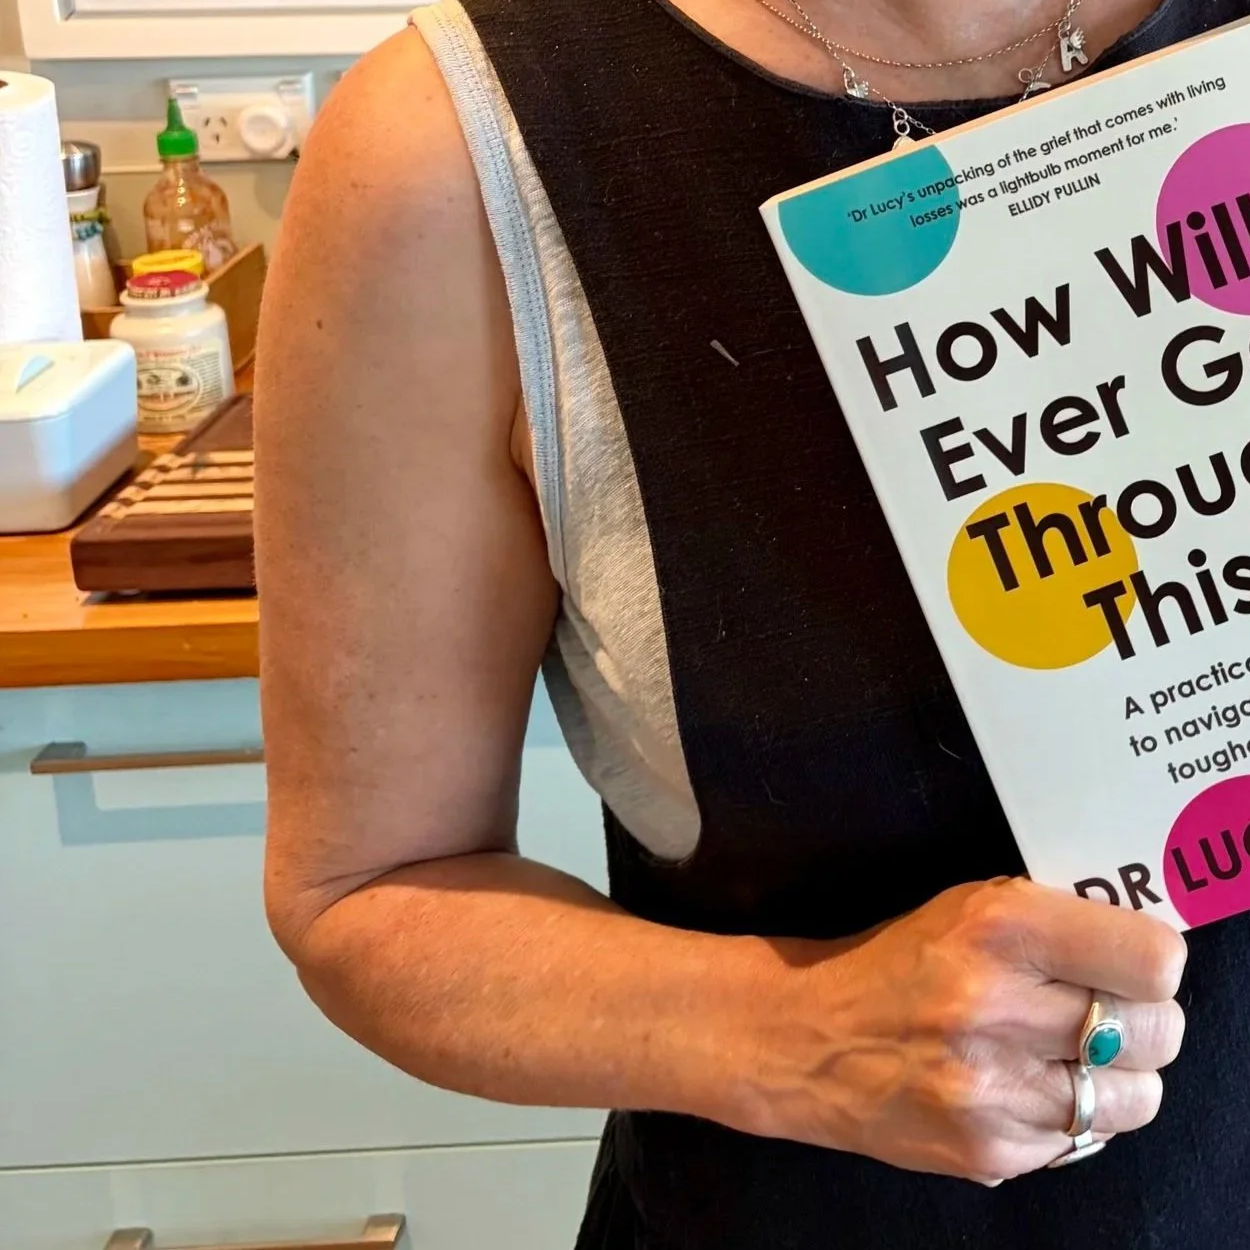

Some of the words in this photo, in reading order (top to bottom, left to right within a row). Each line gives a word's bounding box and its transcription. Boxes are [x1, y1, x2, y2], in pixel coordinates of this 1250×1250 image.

[909, 204, 954, 228] losses
[954, 192, 985, 211] was
[987, 187, 998, 199] a
[999, 163, 1062, 194] lightbulb
[1064, 137, 1125, 171] moment
[1125, 132, 1145, 148] for
[916, 163, 995, 199] unpacking
[997, 153, 1011, 169] of
[1012, 147, 1037, 163] the
[1040, 130, 1072, 156] grief
[1073, 120, 1102, 141] that
[1105, 103, 1154, 129] comes
[1155, 90, 1186, 109] with
[1186, 77, 1226, 99] living
[1007, 190, 1051, 217] ELLIDY
[1053, 173, 1101, 200] PULLIN
[855, 282, 1071, 412] How
[919, 374, 1130, 502] Ever
[1125, 696, 1145, 720] A
[1129, 735, 1158, 757] to
